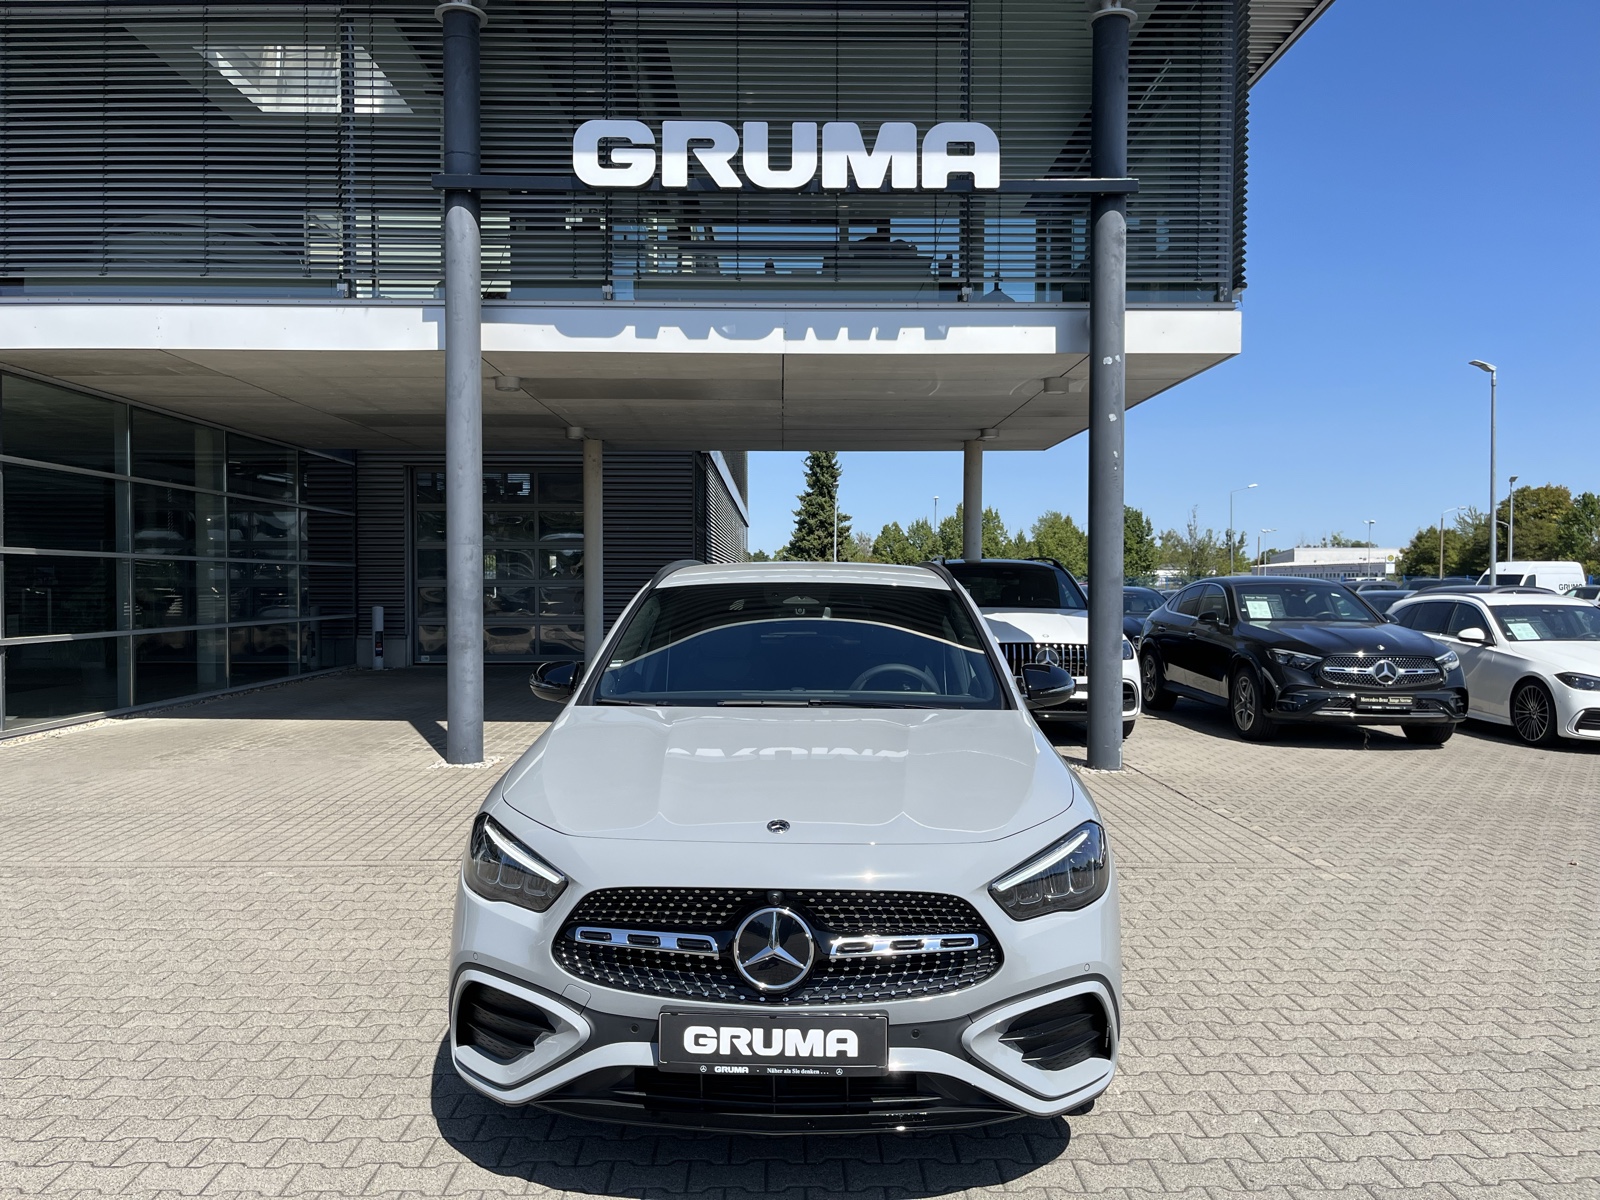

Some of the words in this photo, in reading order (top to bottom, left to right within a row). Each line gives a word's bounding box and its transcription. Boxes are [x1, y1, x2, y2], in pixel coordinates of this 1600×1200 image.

[572, 119, 1001, 190] GRUMA
[683, 1025, 859, 1058] GRUMA
[714, 1065, 749, 1074] GRUMA
